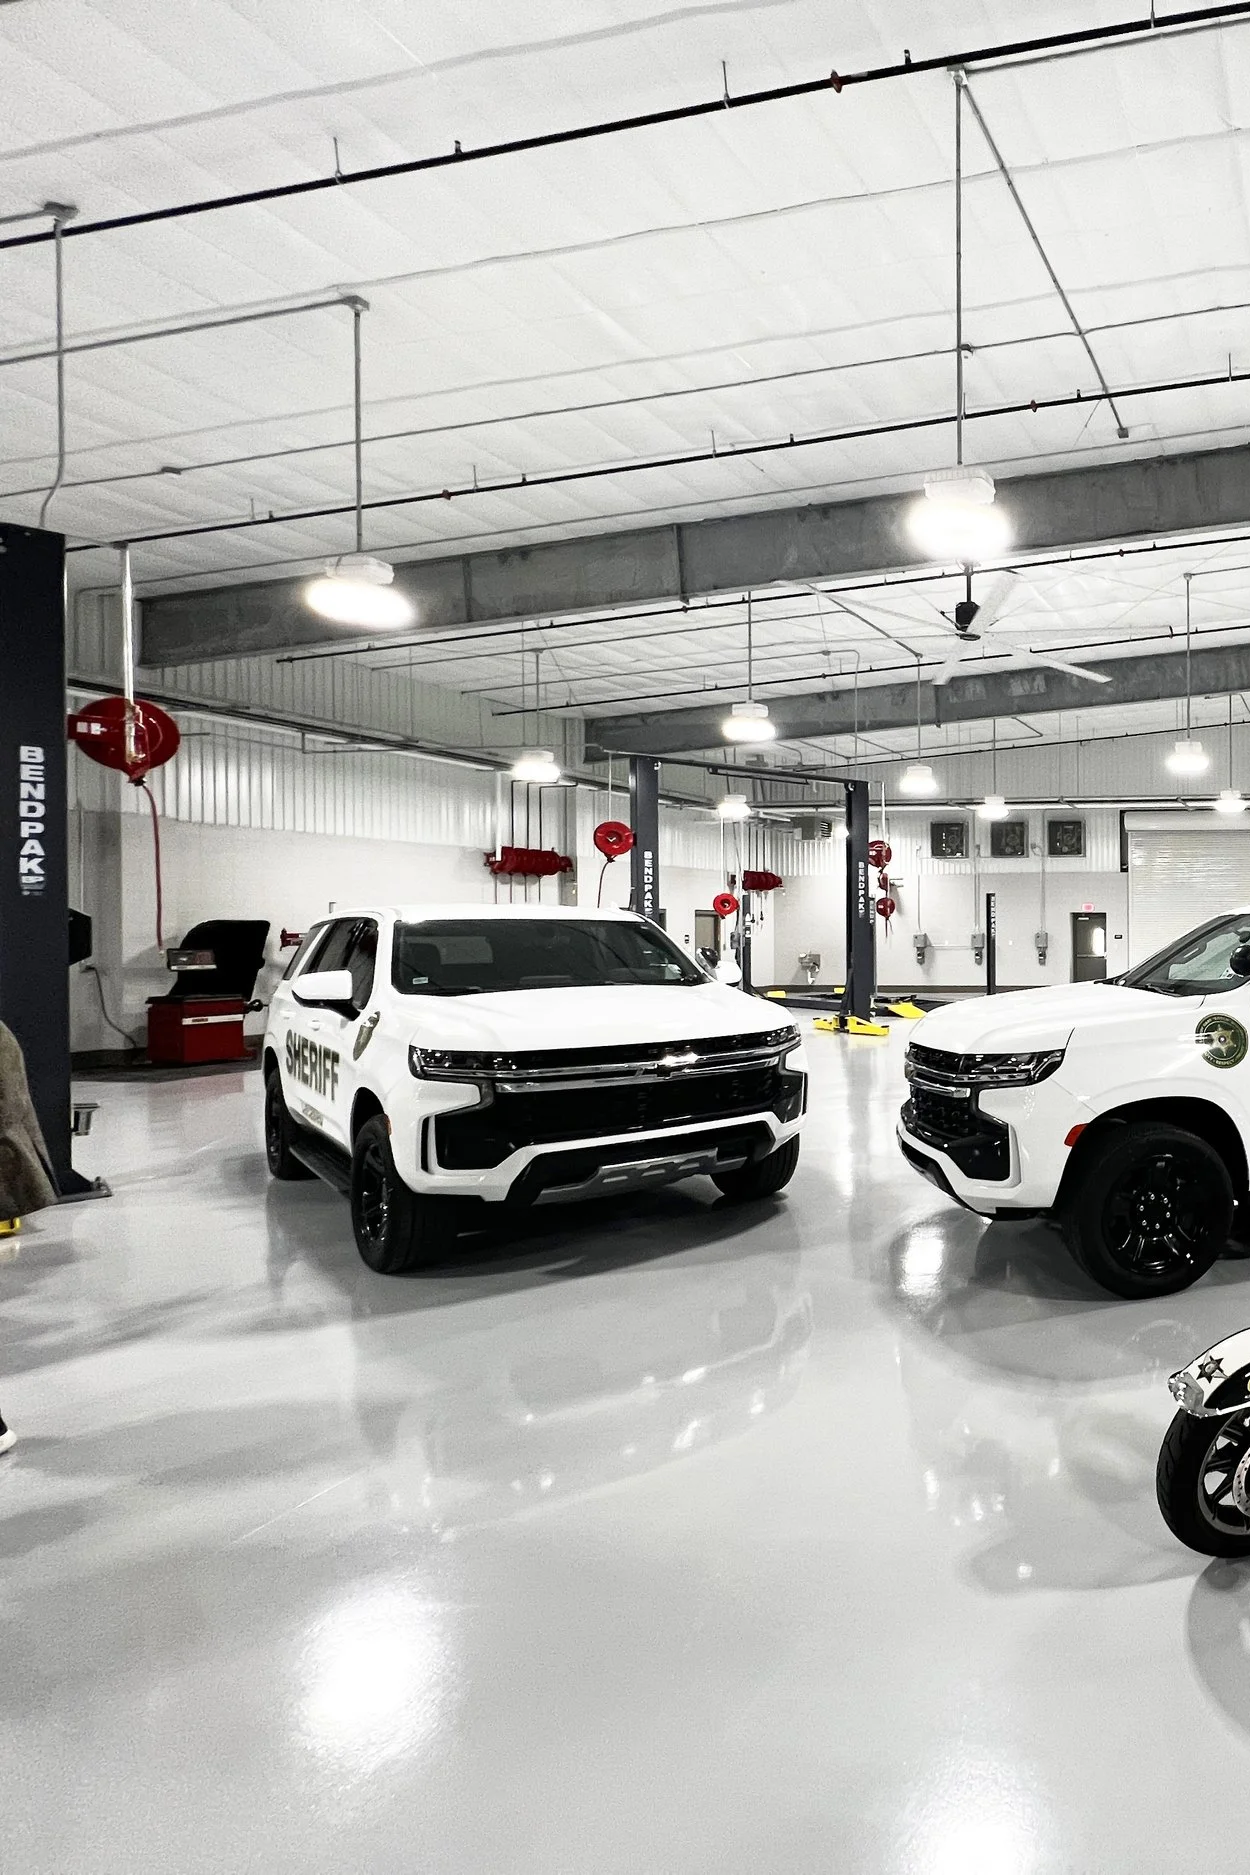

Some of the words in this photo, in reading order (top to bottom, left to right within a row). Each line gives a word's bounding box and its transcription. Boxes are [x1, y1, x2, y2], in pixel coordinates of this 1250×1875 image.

[19, 745, 46, 875] BENDPAK
[643, 850, 653, 908] BENDPAK
[286, 1029, 340, 1103] SHERIFF
